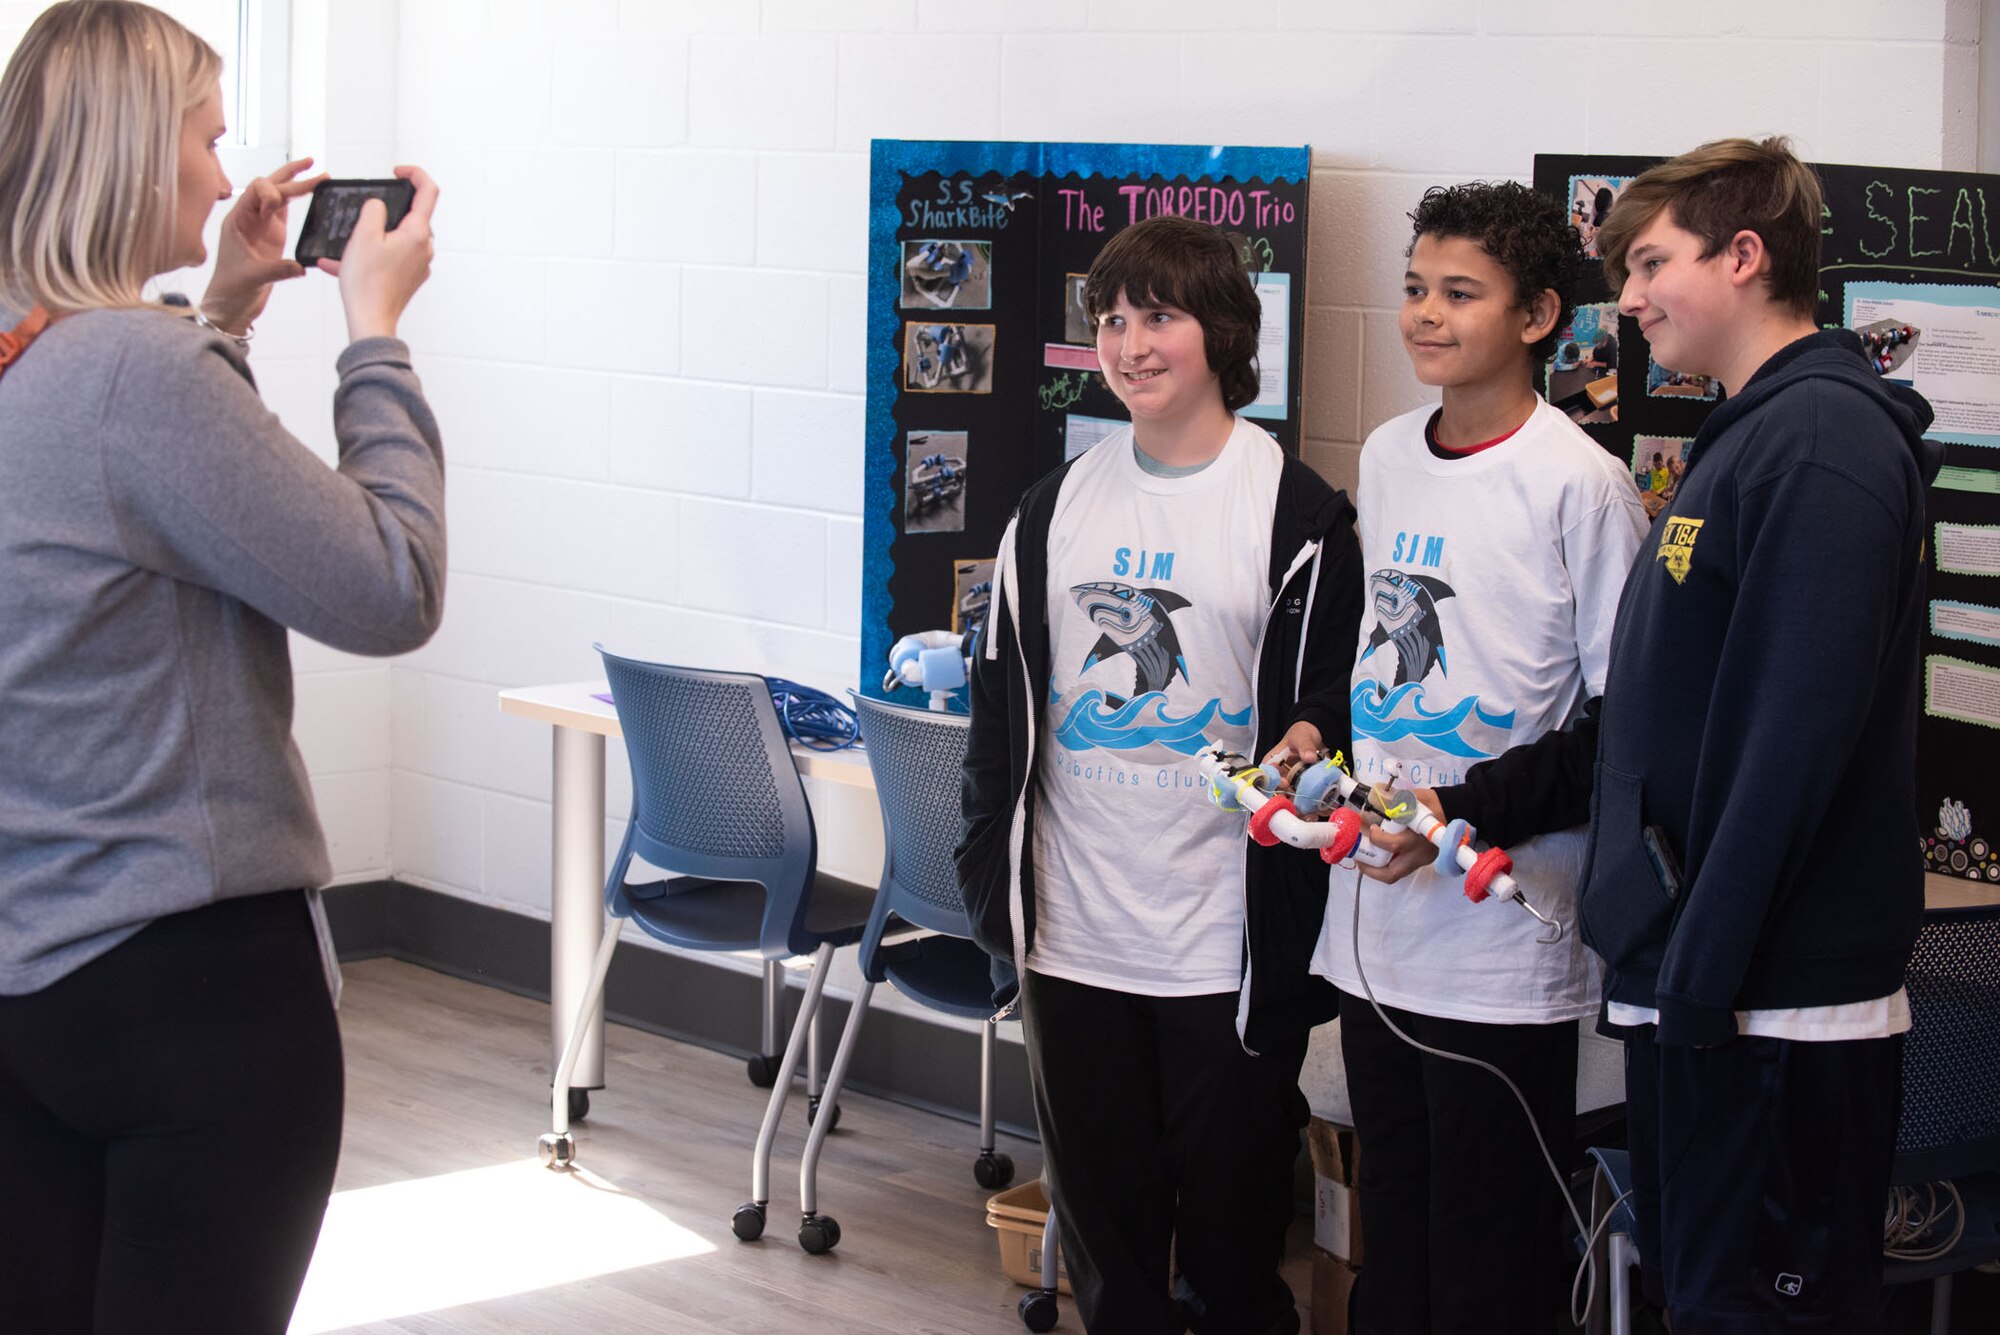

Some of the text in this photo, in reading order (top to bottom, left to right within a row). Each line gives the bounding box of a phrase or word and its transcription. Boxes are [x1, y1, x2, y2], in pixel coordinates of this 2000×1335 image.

[1057, 185, 1296, 232] The TORPEDO Trio
[1392, 531, 1445, 567] SJM
[1673, 524, 1700, 547] 164
[1113, 547, 1175, 581] SJM
[1057, 752, 1208, 788] Robotics Club
[1410, 764, 1461, 785] Club
